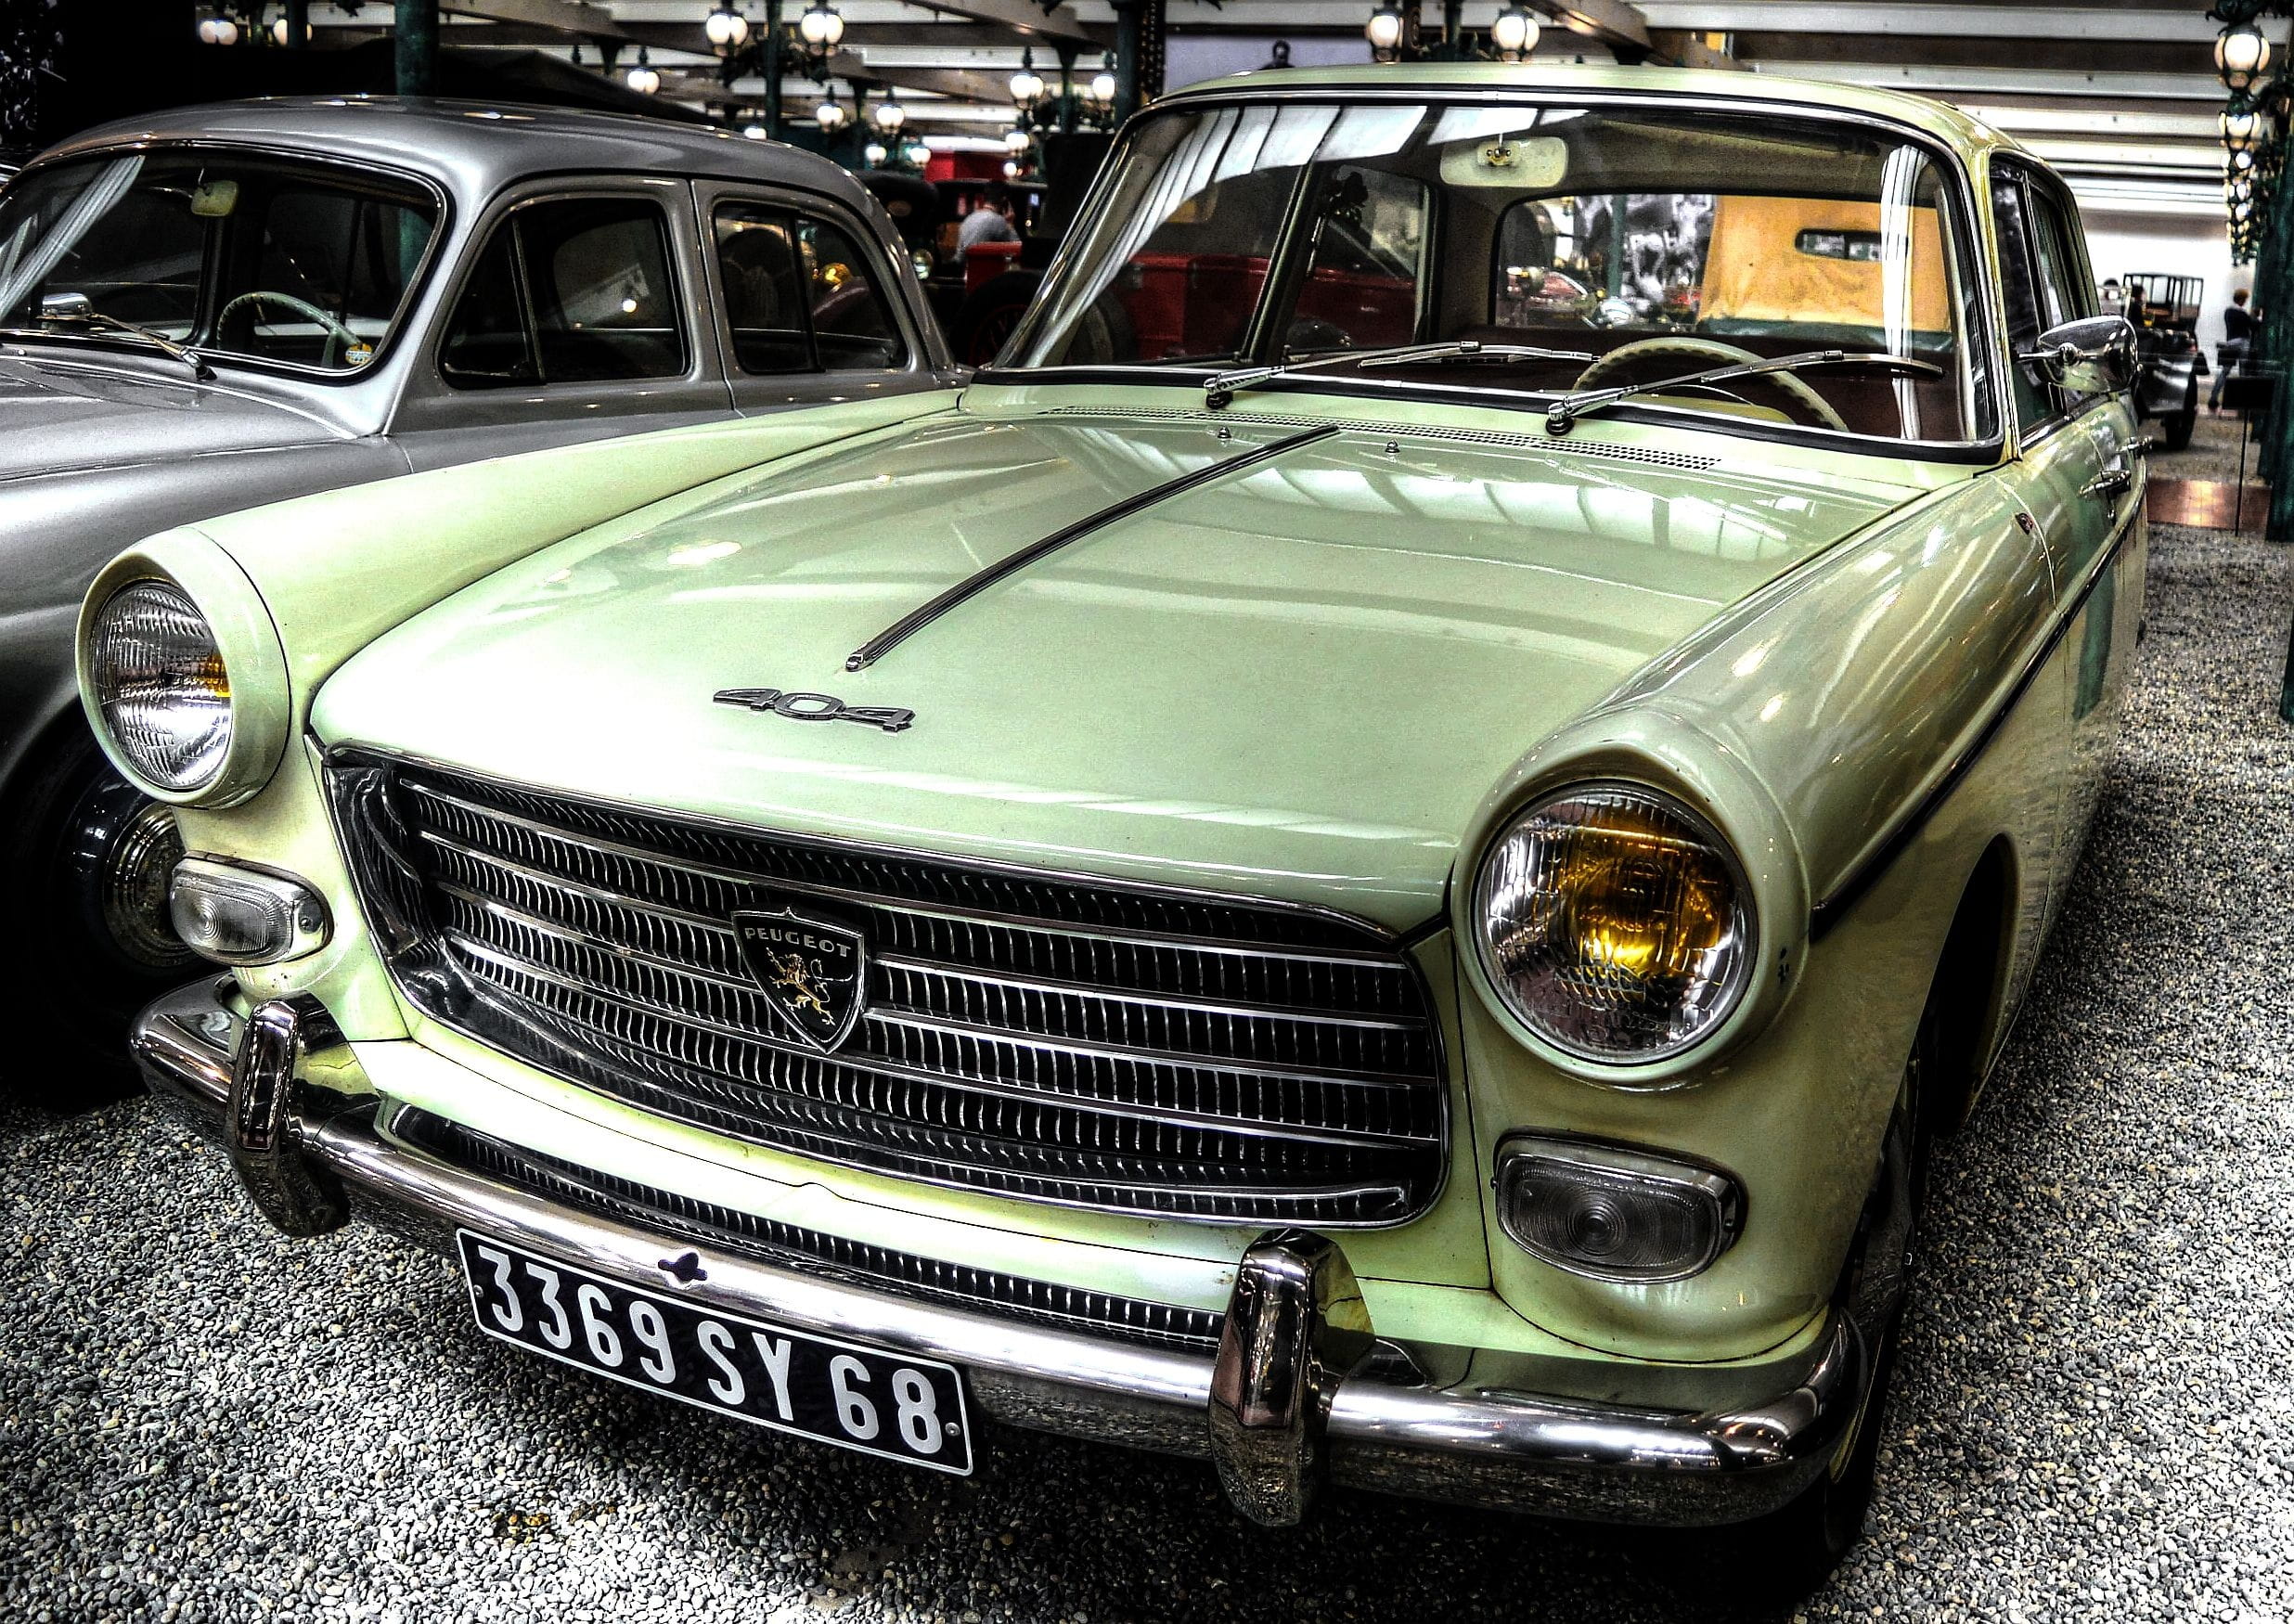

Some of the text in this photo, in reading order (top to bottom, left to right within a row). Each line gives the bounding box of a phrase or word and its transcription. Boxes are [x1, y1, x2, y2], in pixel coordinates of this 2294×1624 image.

[713, 688, 916, 732] 404
[744, 927, 852, 958] PEUGEOT
[478, 1244, 943, 1455] 3369 SY 68
